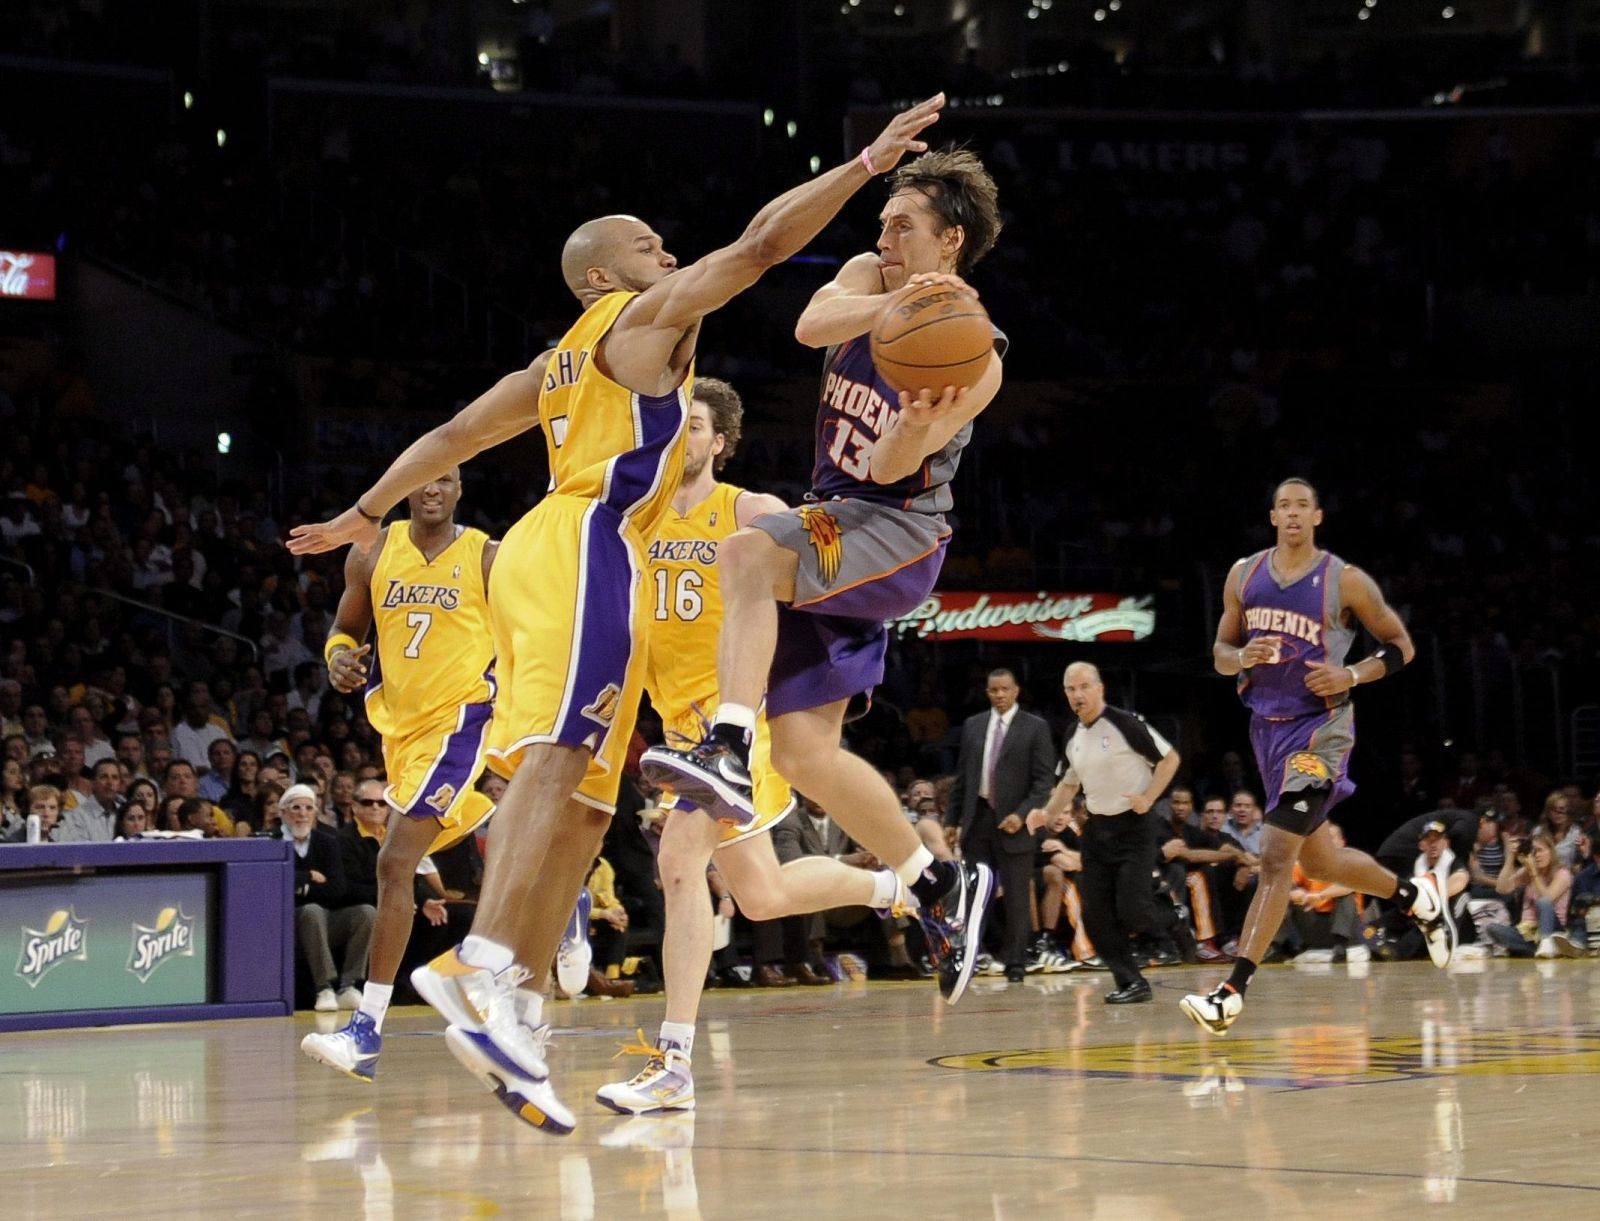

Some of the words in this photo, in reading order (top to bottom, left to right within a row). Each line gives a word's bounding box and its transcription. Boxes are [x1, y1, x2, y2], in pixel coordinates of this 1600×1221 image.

[823, 371, 899, 440] PHOEN
[824, 418, 875, 481] 13
[648, 540, 718, 565] AKERS
[380, 580, 460, 610] LAKERS
[654, 568, 704, 621] 16
[884, 591, 1094, 639] Budweiser
[404, 612, 432, 659] 7
[1245, 607, 1321, 646] PHOENIX
[23, 922, 82, 974] Sprite
[134, 918, 189, 970] Sprite
